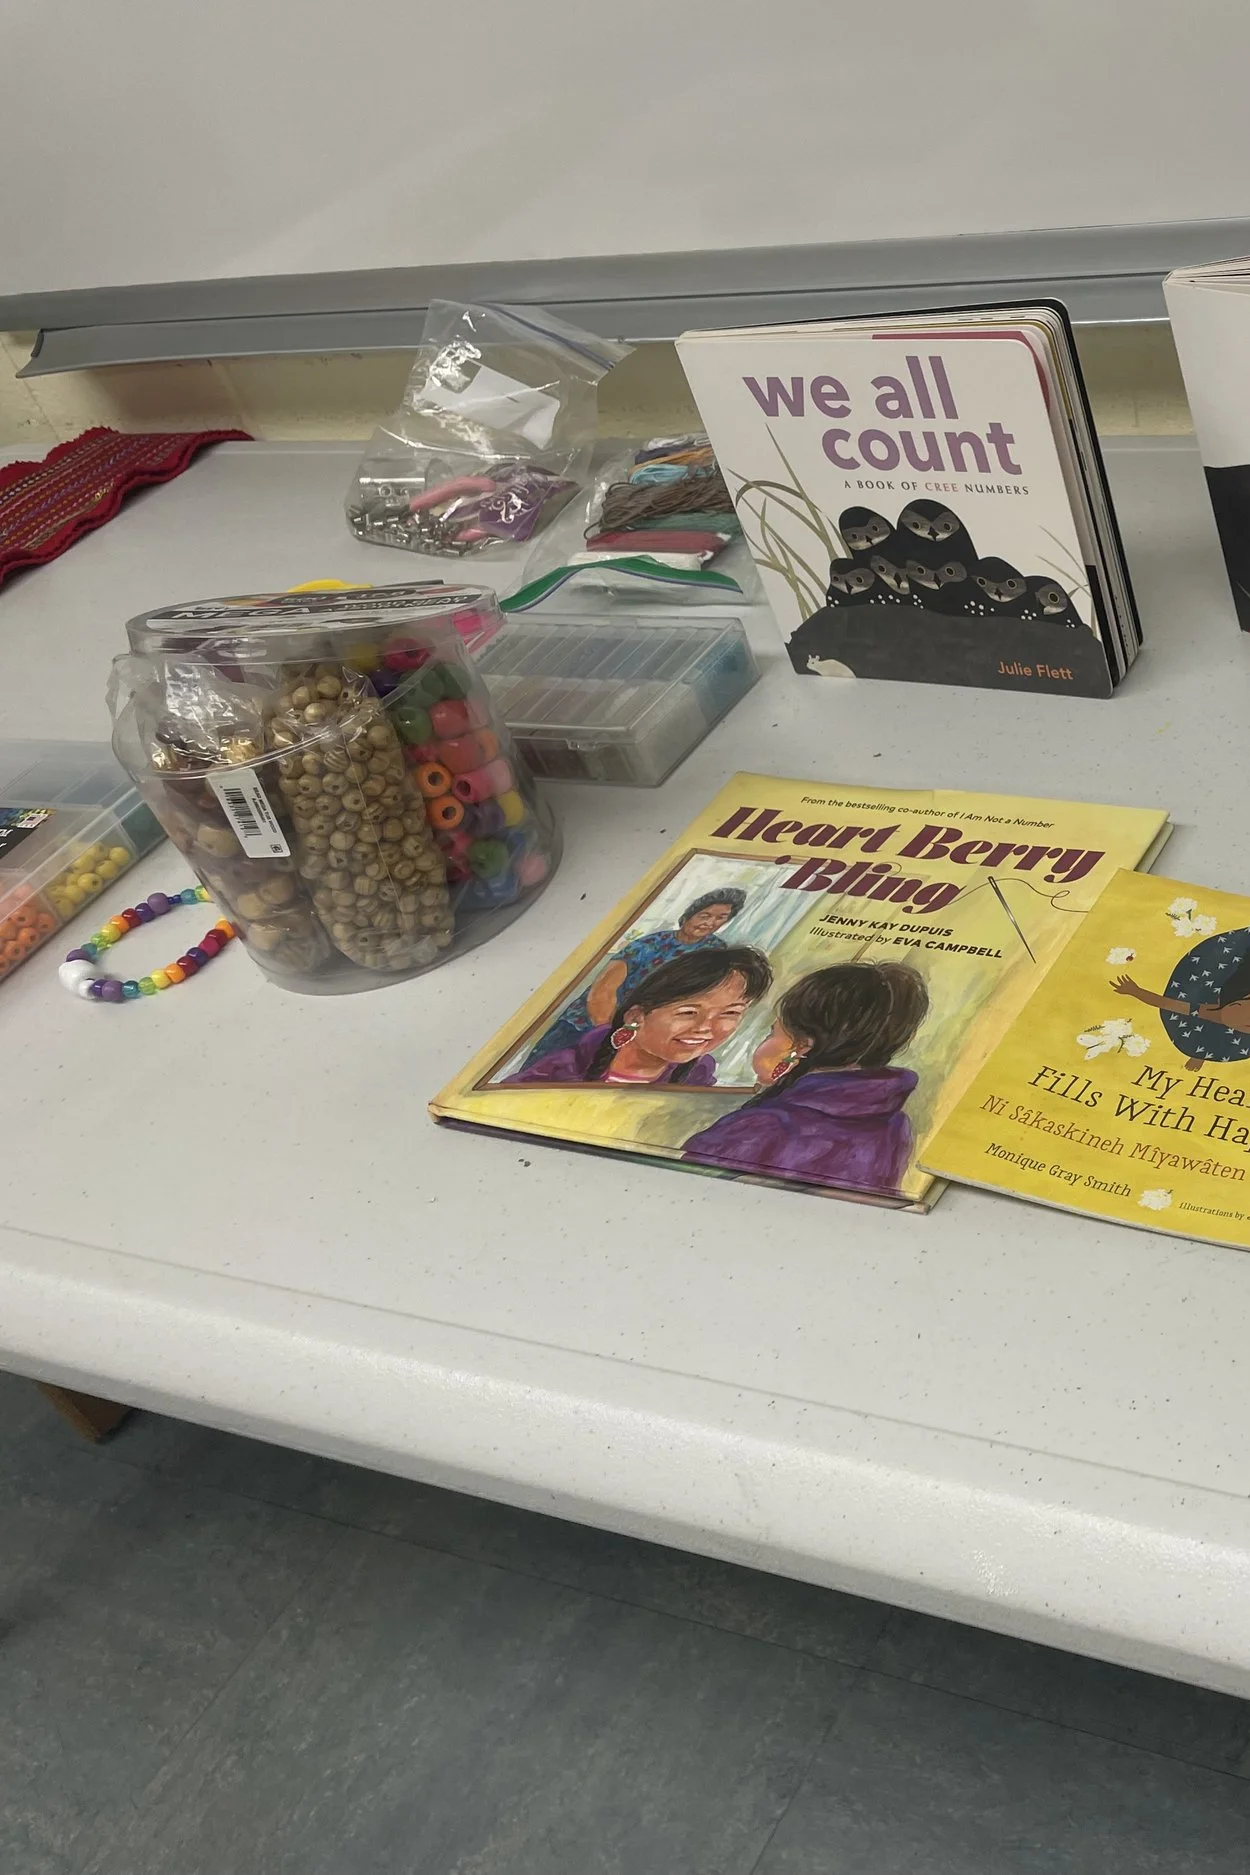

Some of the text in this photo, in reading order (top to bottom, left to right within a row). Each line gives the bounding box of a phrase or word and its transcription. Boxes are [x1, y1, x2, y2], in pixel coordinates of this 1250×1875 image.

[742, 356, 959, 420] we all
[821, 422, 1022, 475] count
[844, 480, 1029, 495] A BOOK OF CREE NUMBERS
[174, 608, 311, 619] MEGA
[997, 661, 1073, 681] Julie Flett
[800, 796, 1054, 829] From the bestselling co-author of I Am Not a Number
[708, 806, 1106, 884] Heart Berry
[775, 855, 967, 914] Bling
[809, 927, 1004, 959] Illustrated by EVA CAMPBELL
[820, 914, 954, 937] JENNY KAY DUPUIS
[1028, 1065, 1103, 1108] Fills
[1115, 1094, 1196, 1133] With
[1131, 1065, 1181, 1100] My
[979, 1095, 1005, 1115] Ni
[1008, 1105, 1125, 1156] Sâkaskineh
[1128, 1142, 1245, 1181] Mîyawâten
[984, 1142, 1131, 1197] Monique Gray Smith
[1234, 1212, 1245, 1220] by
